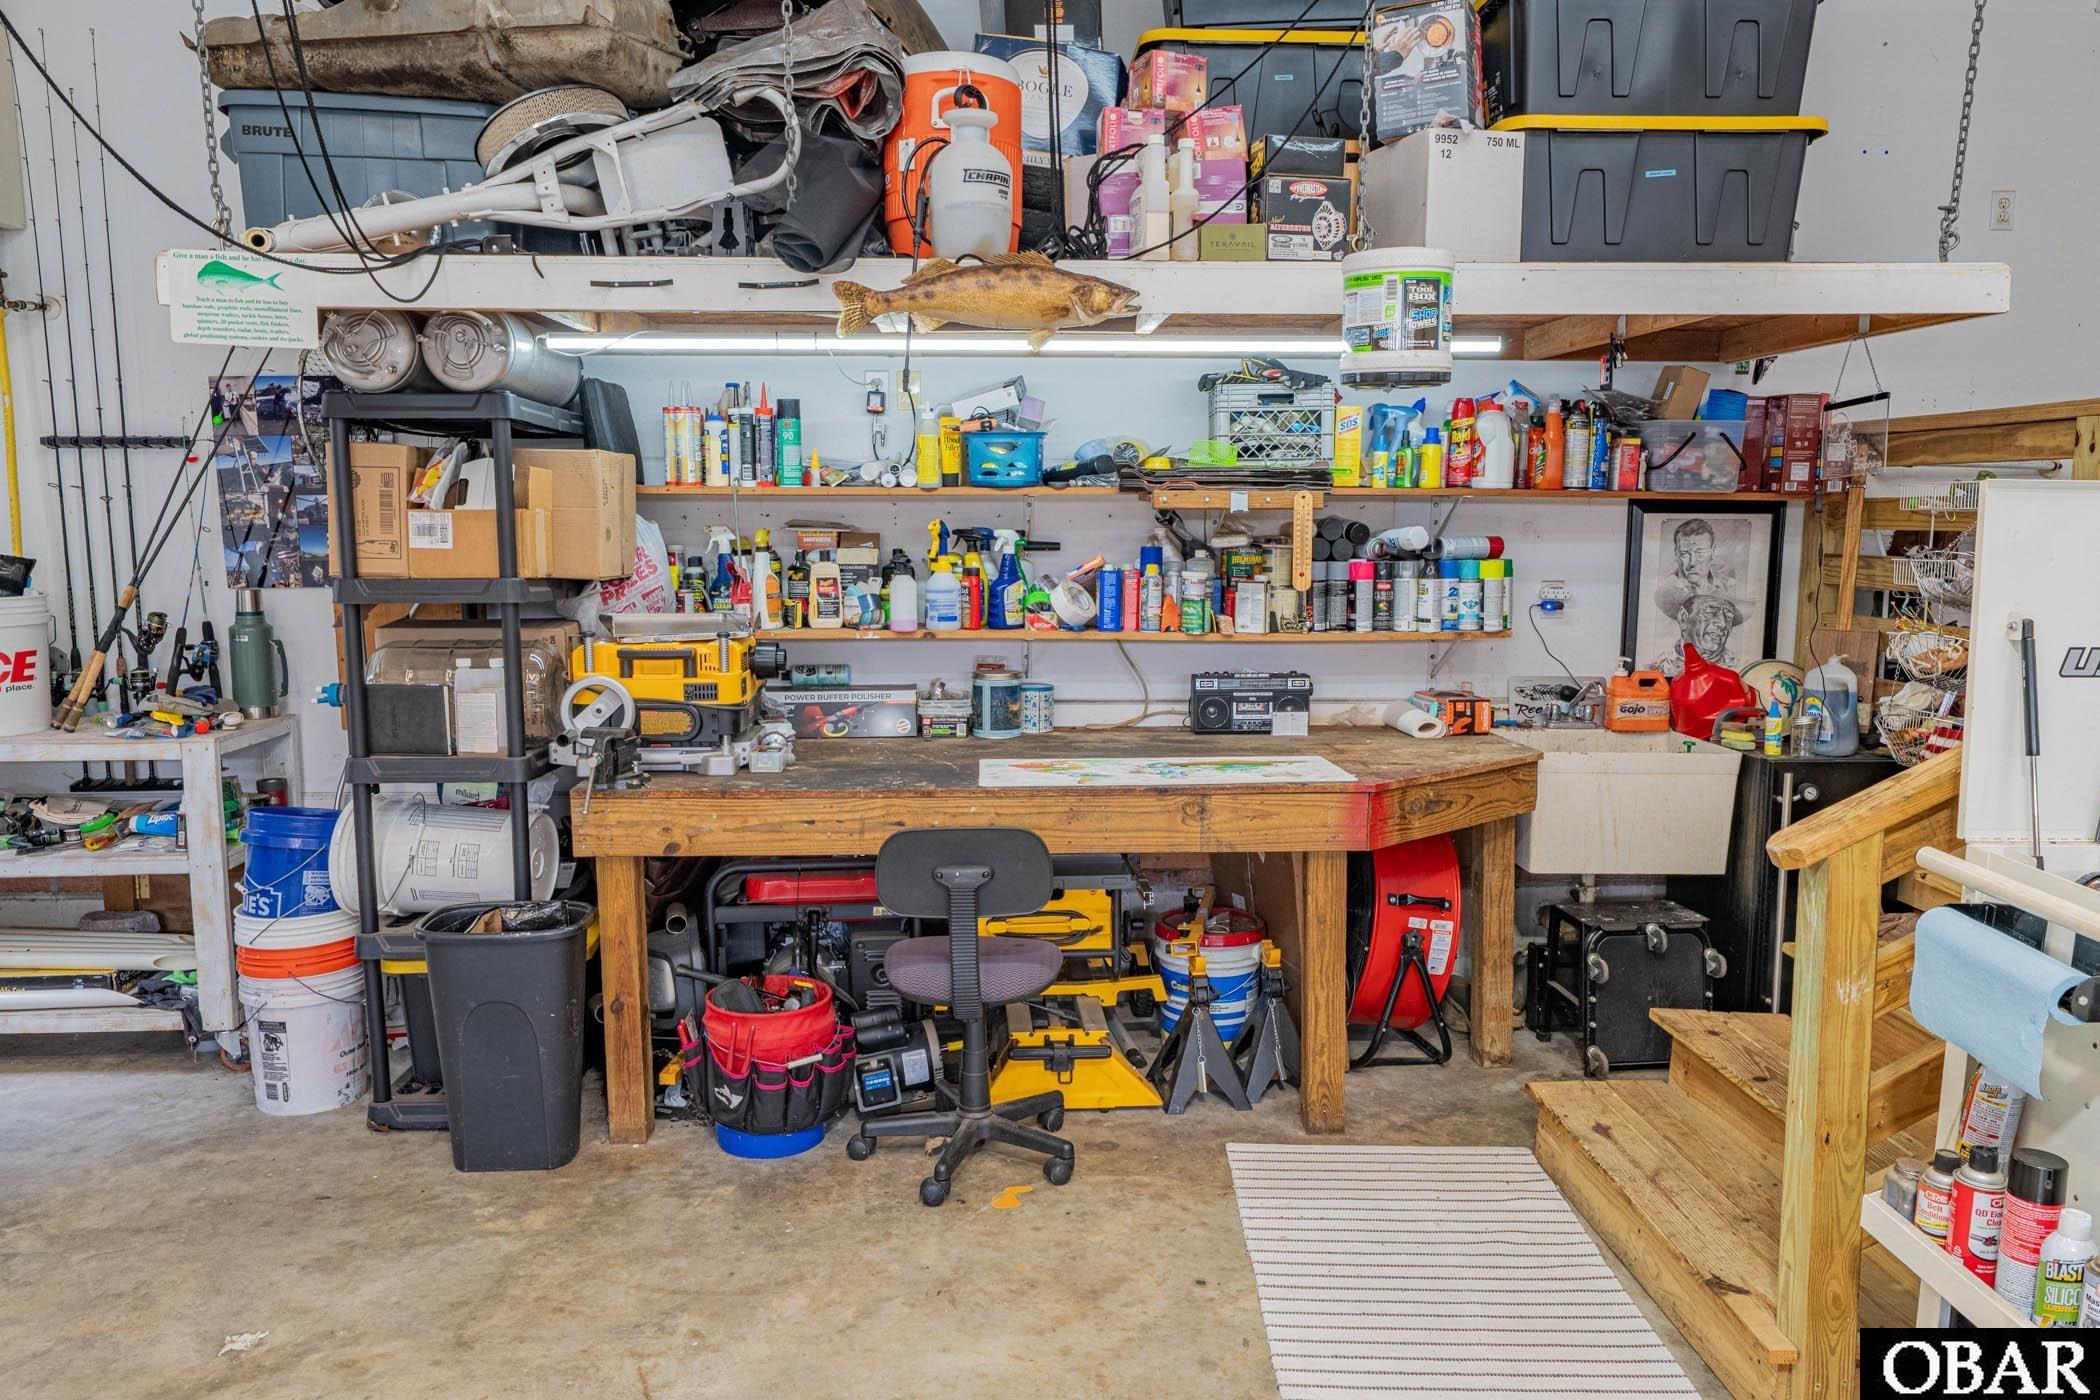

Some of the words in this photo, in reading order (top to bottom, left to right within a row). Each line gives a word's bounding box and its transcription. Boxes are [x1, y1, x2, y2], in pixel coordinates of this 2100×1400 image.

[241, 124, 292, 138] BRUTE
[1434, 133, 1458, 145] 9952
[1486, 136, 1503, 147] 750
[1506, 138, 1521, 149] ML
[1440, 149, 1452, 159] 12
[968, 171, 1009, 184] CHAPIN
[1210, 240, 1256, 249] TERAVAIL
[1408, 292, 1436, 301] BOX
[1411, 308, 1439, 320] SHOP
[1408, 318, 1437, 329] TOWELS
[782, 430, 794, 441] 90
[1451, 429, 1471, 443] Raid
[784, 694, 816, 702] POWER
[817, 693, 849, 701] BUFFER
[851, 692, 892, 700] POLISHER
[146, 813, 175, 825] Ziploc
[1927, 1200, 1943, 1213] Belt
[1975, 1208, 1988, 1218] QD
